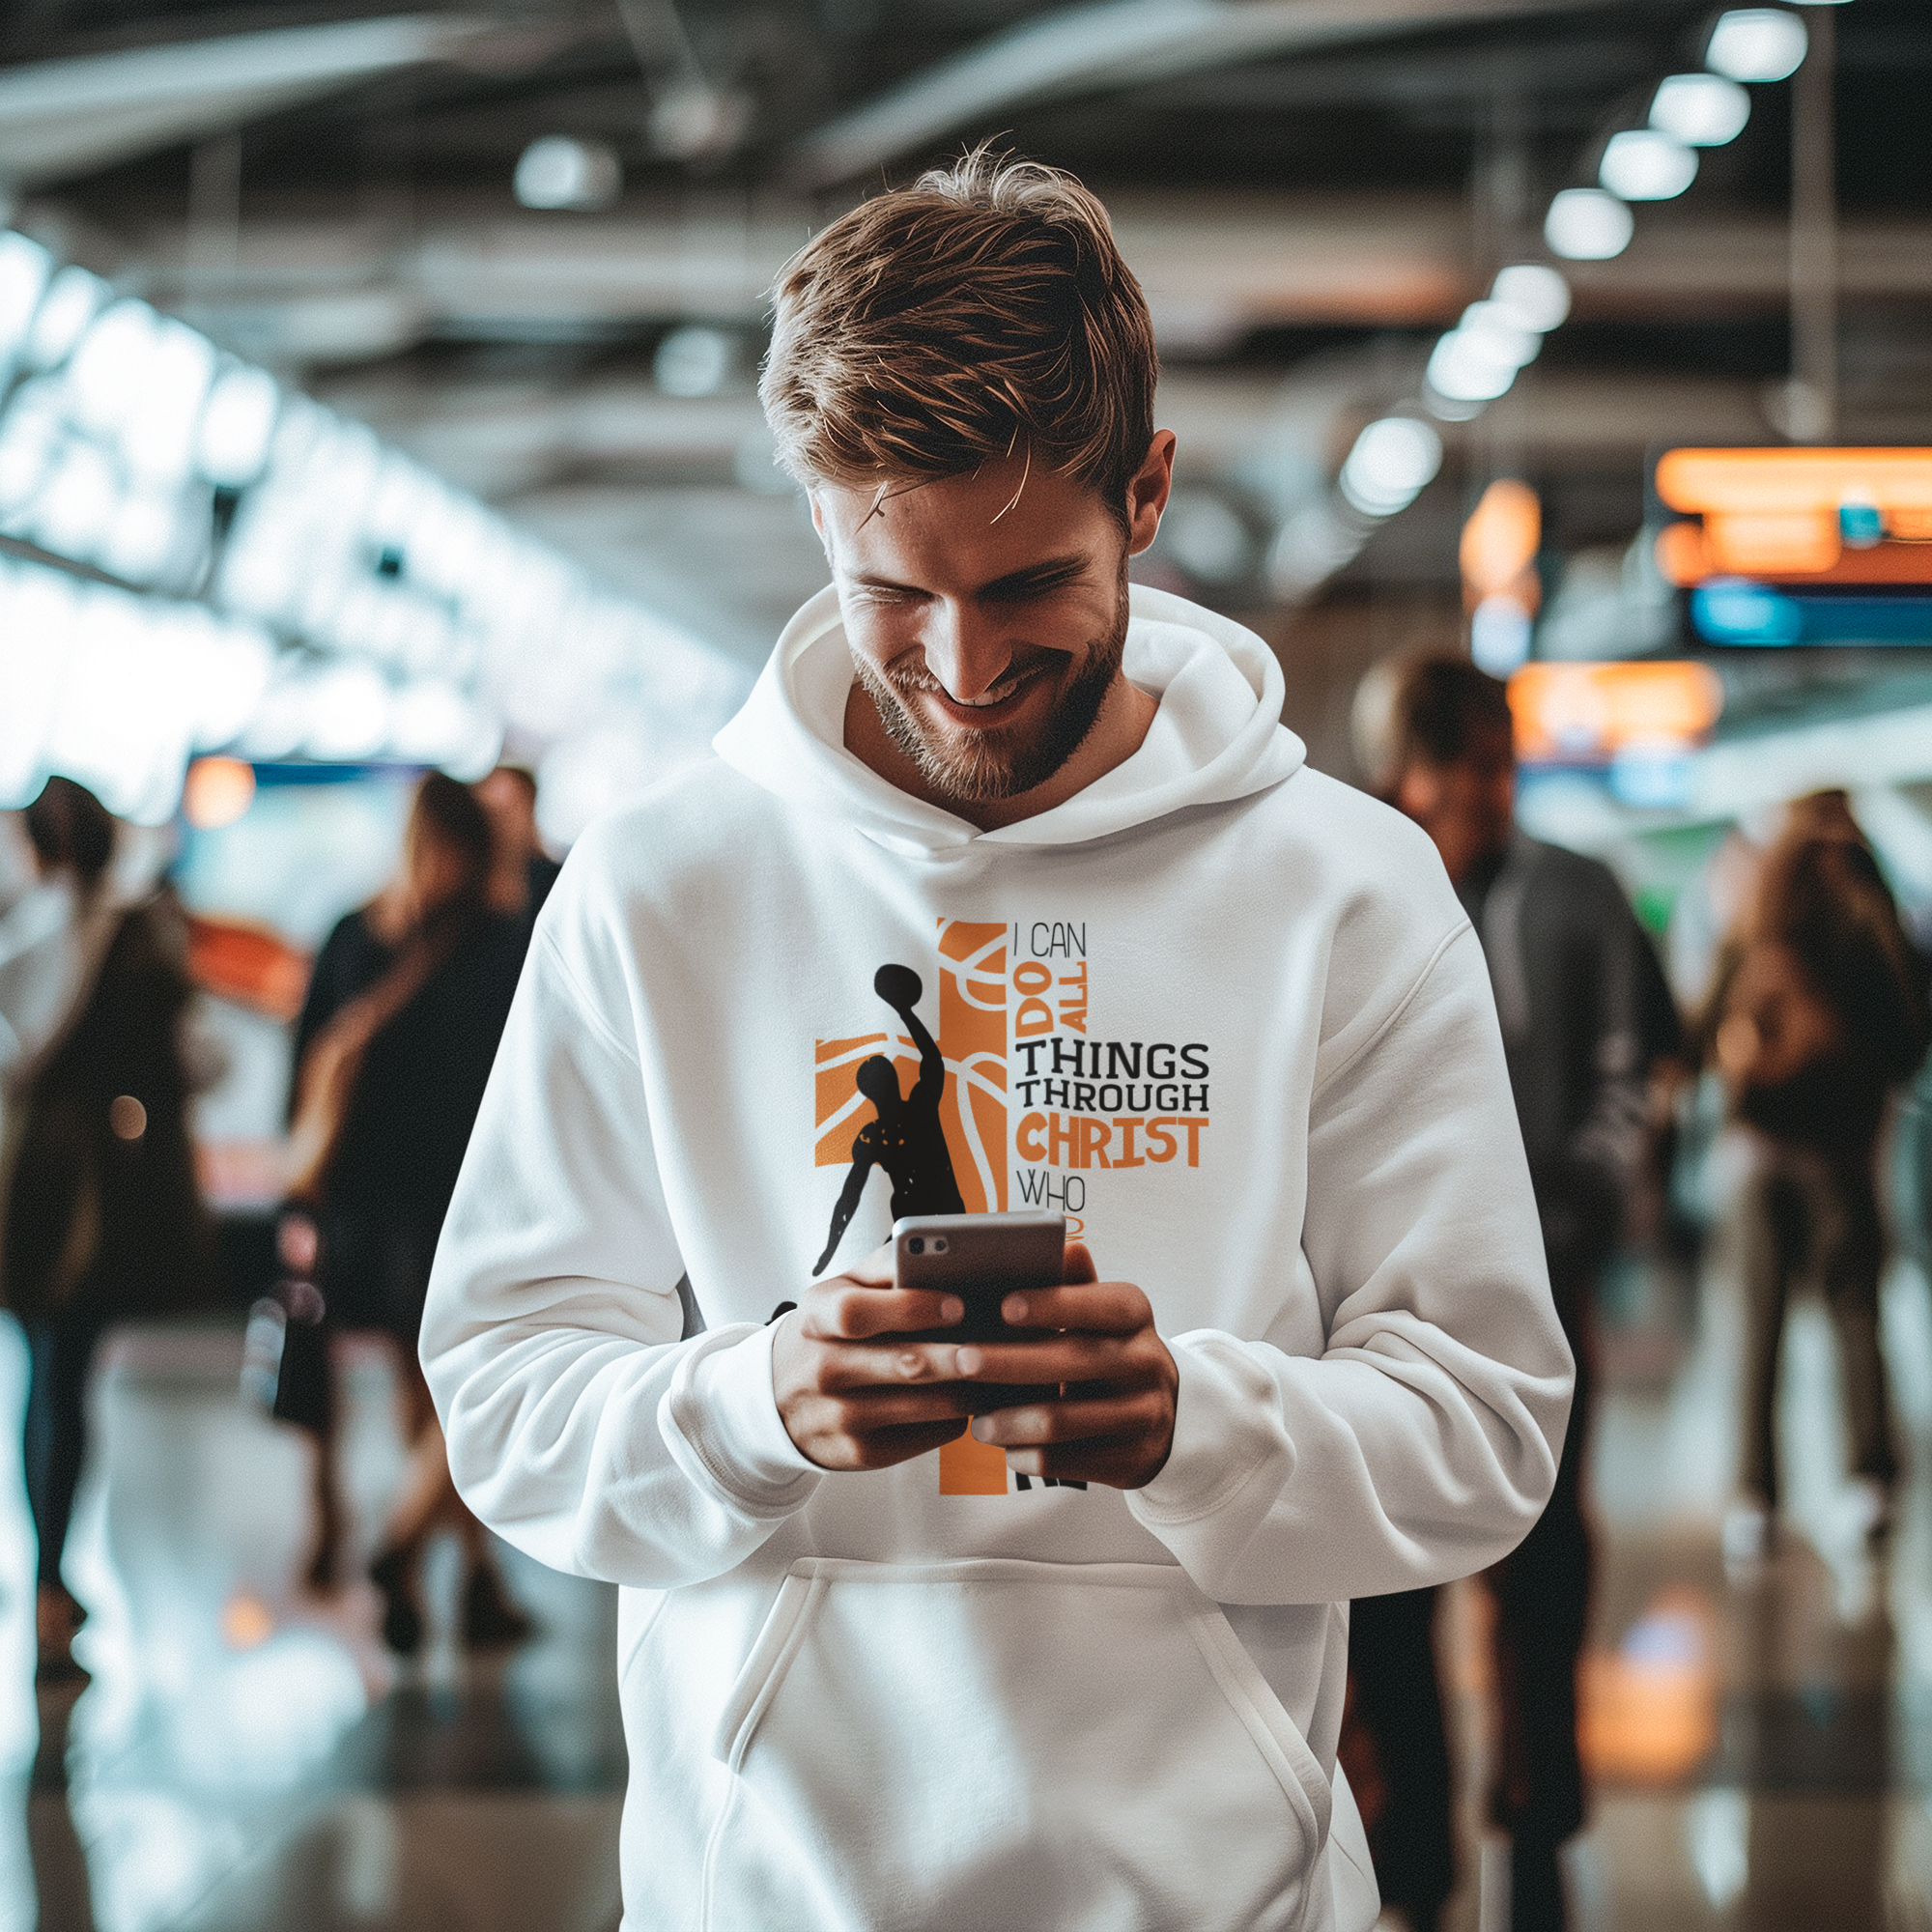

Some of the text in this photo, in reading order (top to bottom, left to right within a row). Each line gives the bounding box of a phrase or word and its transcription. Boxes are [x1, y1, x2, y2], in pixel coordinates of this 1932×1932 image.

[1013, 922, 1087, 958] I CAN
[1013, 960, 1054, 1038] DO
[1058, 960, 1088, 1035] ALL
[1015, 1037, 1209, 1080] THINGS
[1015, 1078, 1209, 1112] THROUGH
[1015, 1111, 1209, 1169] CHRIST
[1016, 1169, 1086, 1212] WHO
